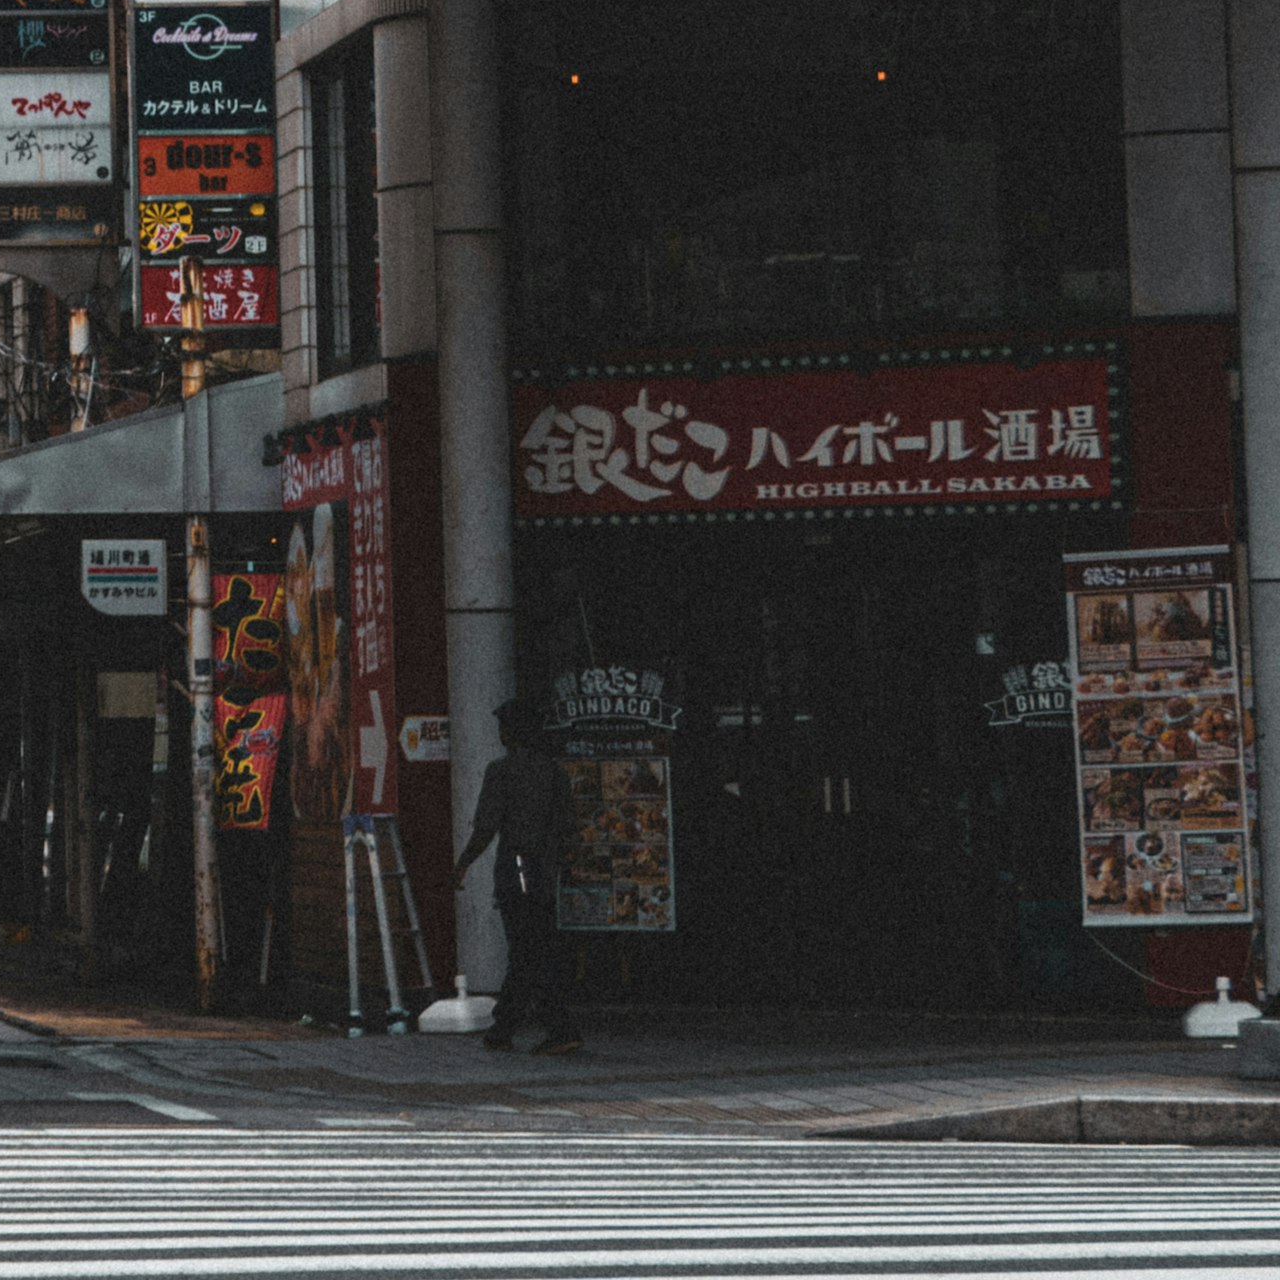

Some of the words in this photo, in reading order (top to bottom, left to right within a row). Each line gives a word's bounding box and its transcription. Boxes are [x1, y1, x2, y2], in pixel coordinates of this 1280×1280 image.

[139, 11, 156, 22] 3F
[189, 81, 223, 93] BAR
[199, 174, 228, 191] bar
[151, 224, 242, 255] ダーツ
[520, 388, 731, 502] 銀だこ
[756, 478, 943, 499] HIGHBALL
[946, 474, 1092, 493] SAKABA
[566, 697, 651, 717] GINDACO
